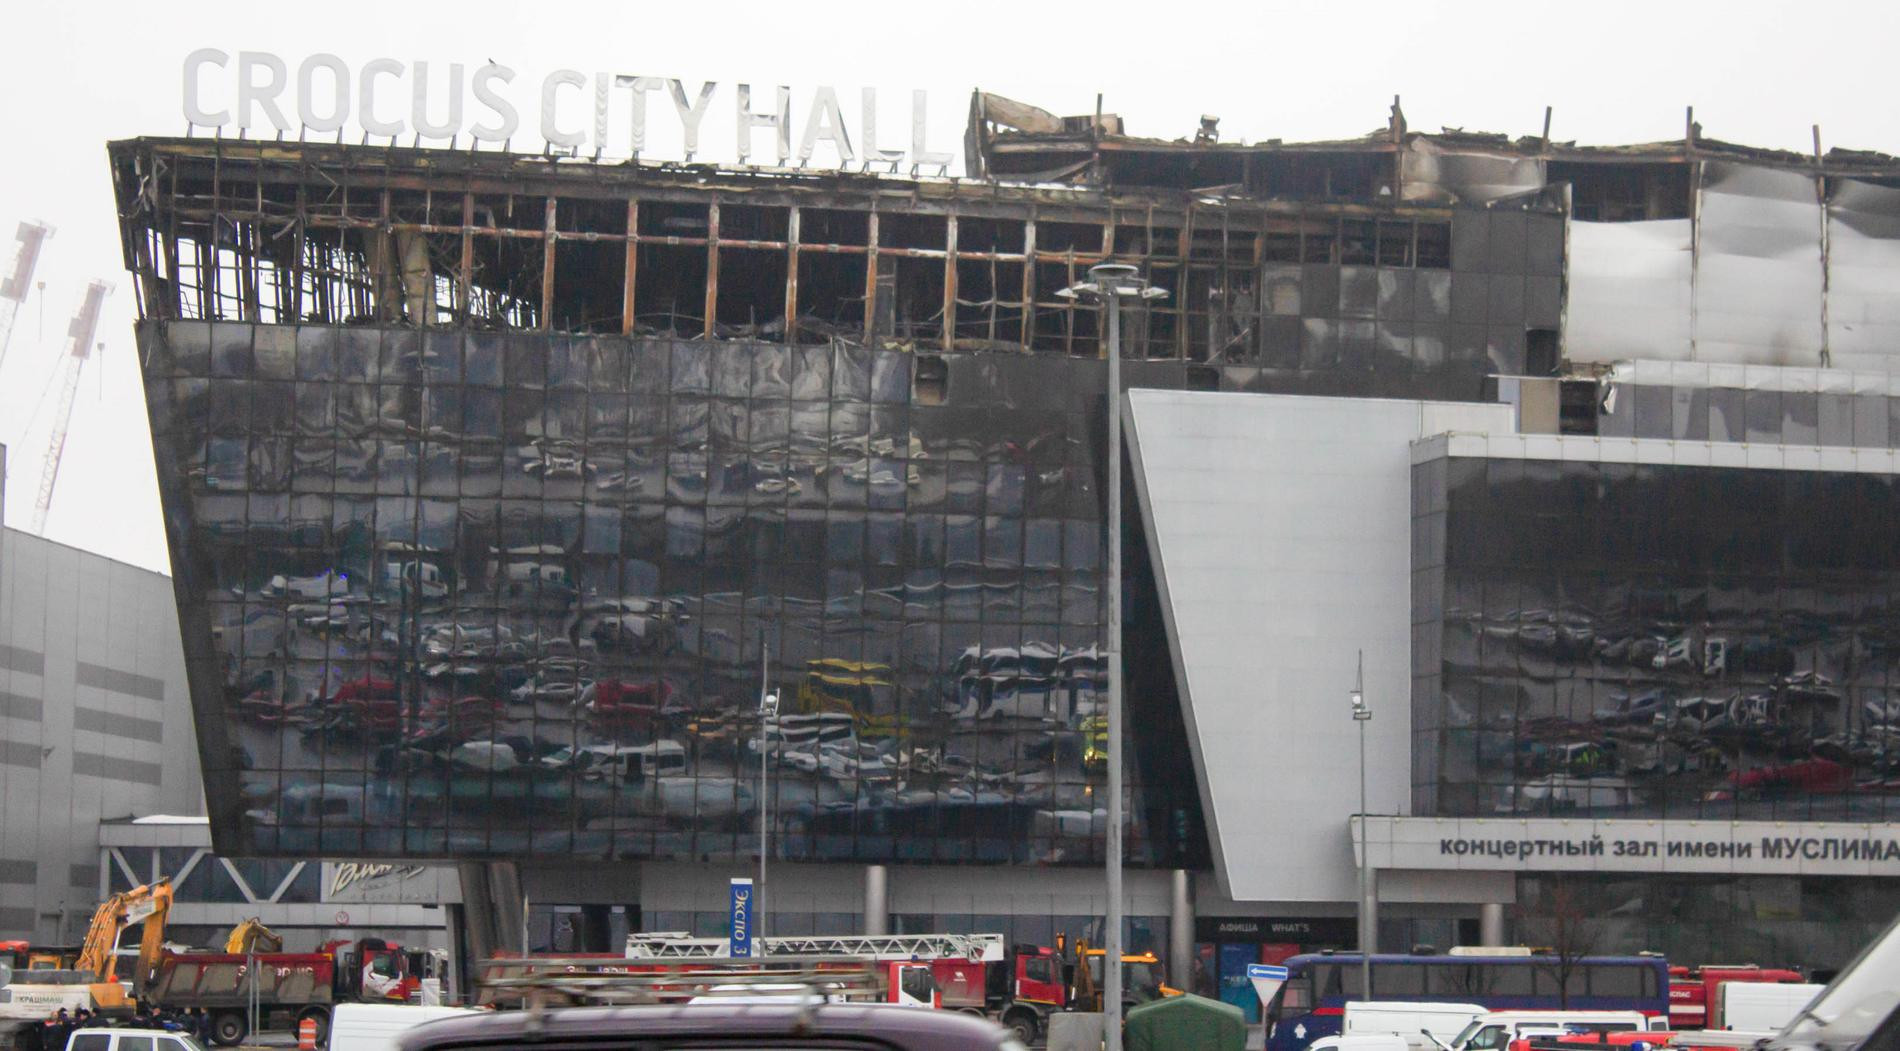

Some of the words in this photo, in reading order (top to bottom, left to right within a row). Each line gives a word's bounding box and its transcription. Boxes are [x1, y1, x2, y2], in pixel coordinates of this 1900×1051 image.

[183, 48, 520, 142] CROCUS
[541, 69, 718, 154] CITY
[737, 84, 953, 165] HALL
[1440, 835, 1603, 859] концертный
[1613, 840, 1657, 857] зал
[1667, 841, 1751, 858] имени
[1761, 838, 1900, 861] МУСЛИМА
[734, 945, 747, 955] 3
